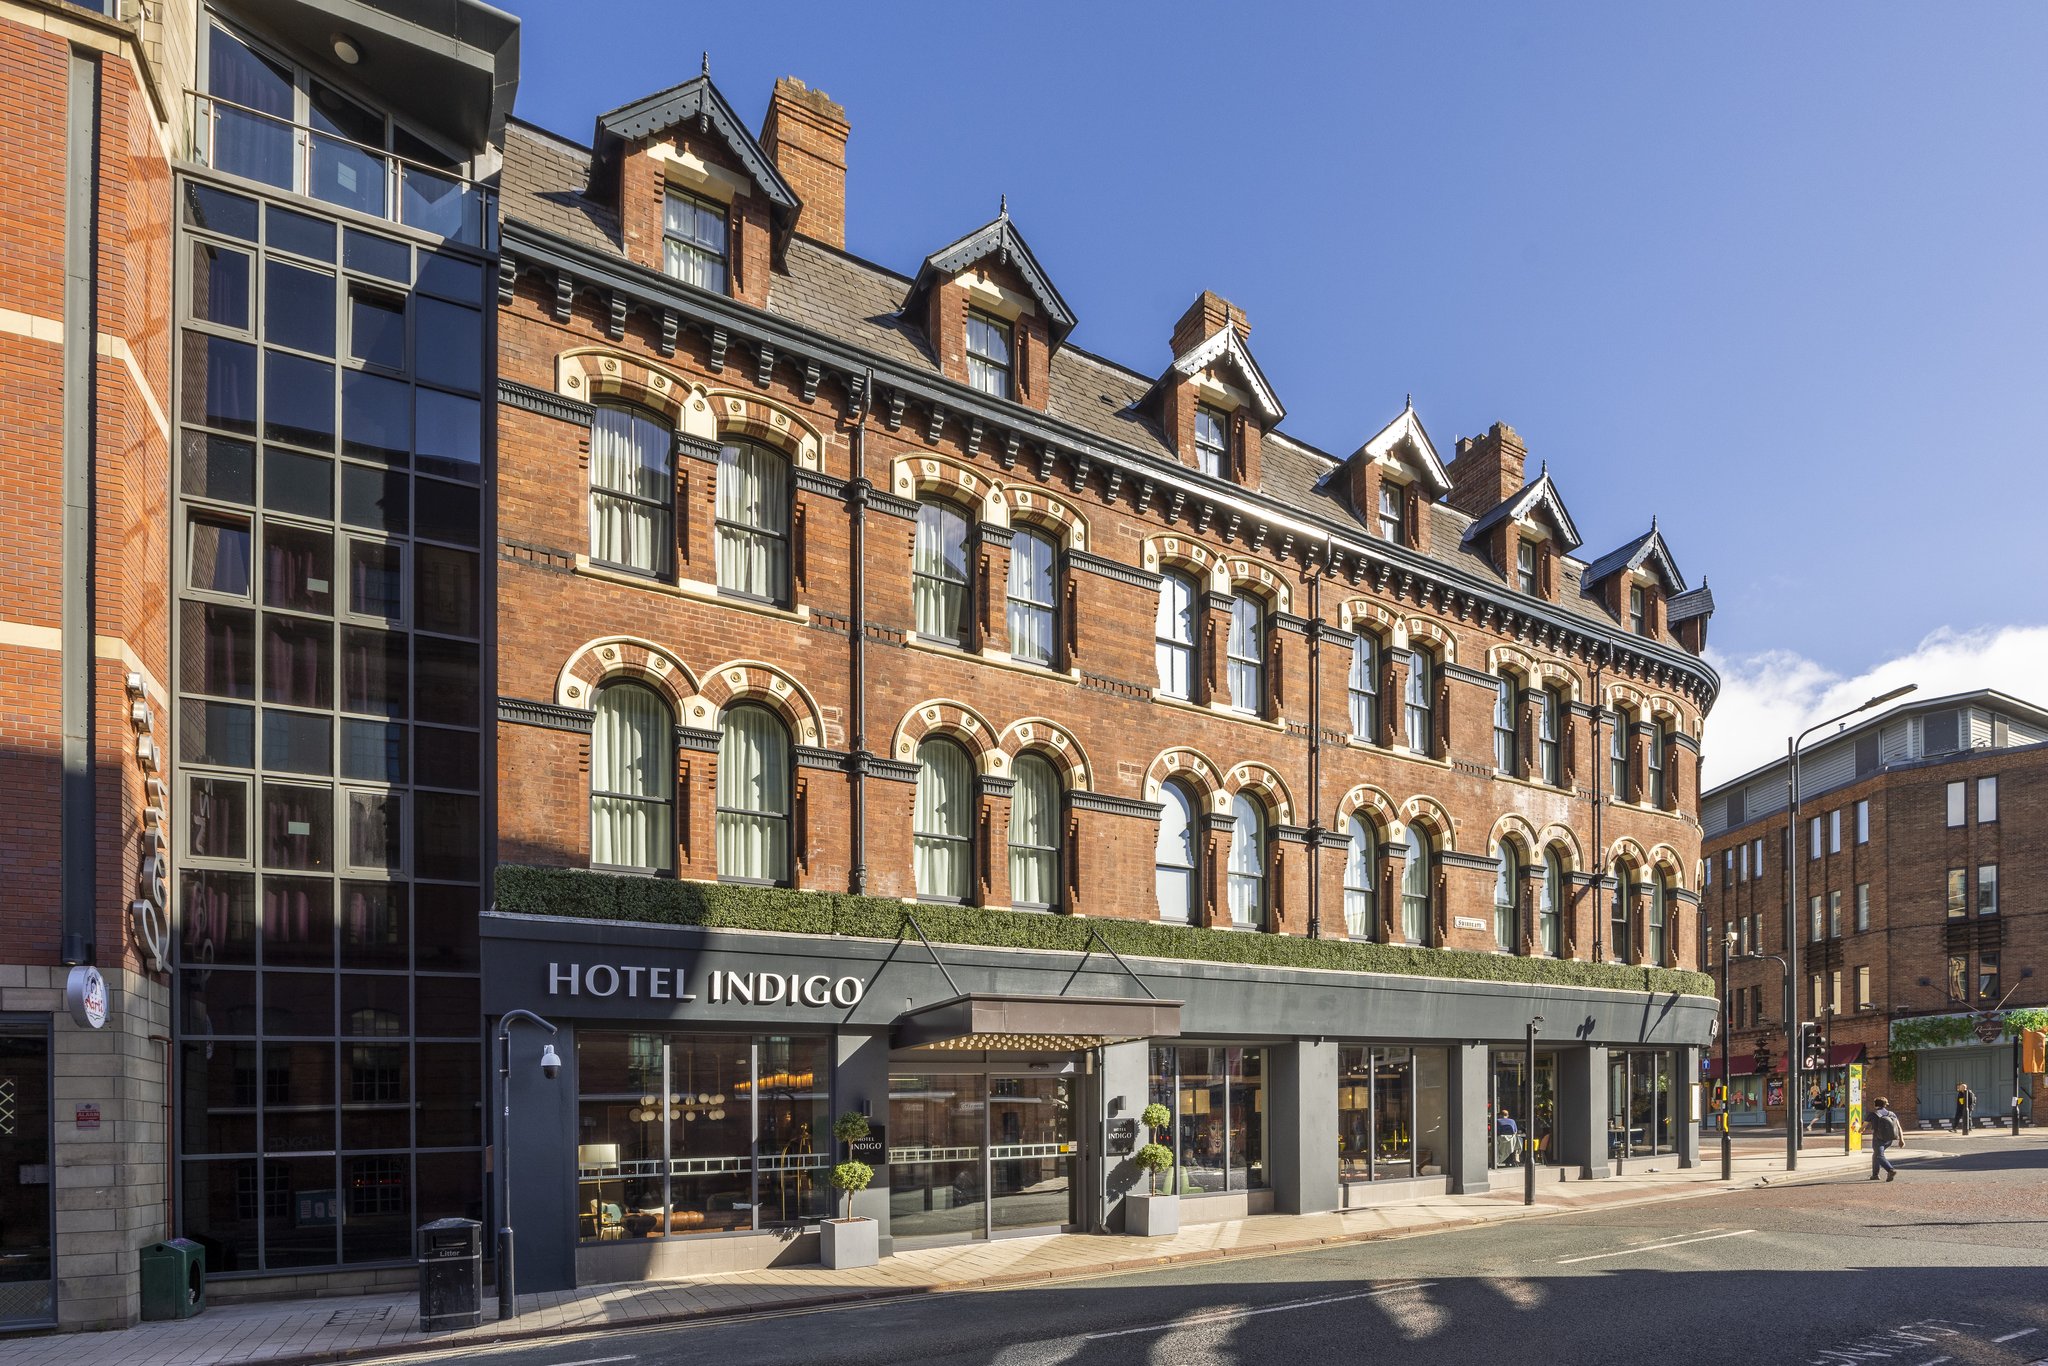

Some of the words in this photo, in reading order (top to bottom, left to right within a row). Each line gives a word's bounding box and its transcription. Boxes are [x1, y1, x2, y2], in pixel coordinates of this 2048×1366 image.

[548, 962, 696, 1000] HOTEL
[709, 969, 864, 1007] INDIGO
[1108, 1132, 1132, 1140] INDIGO
[851, 1142, 882, 1151] INDIGO
